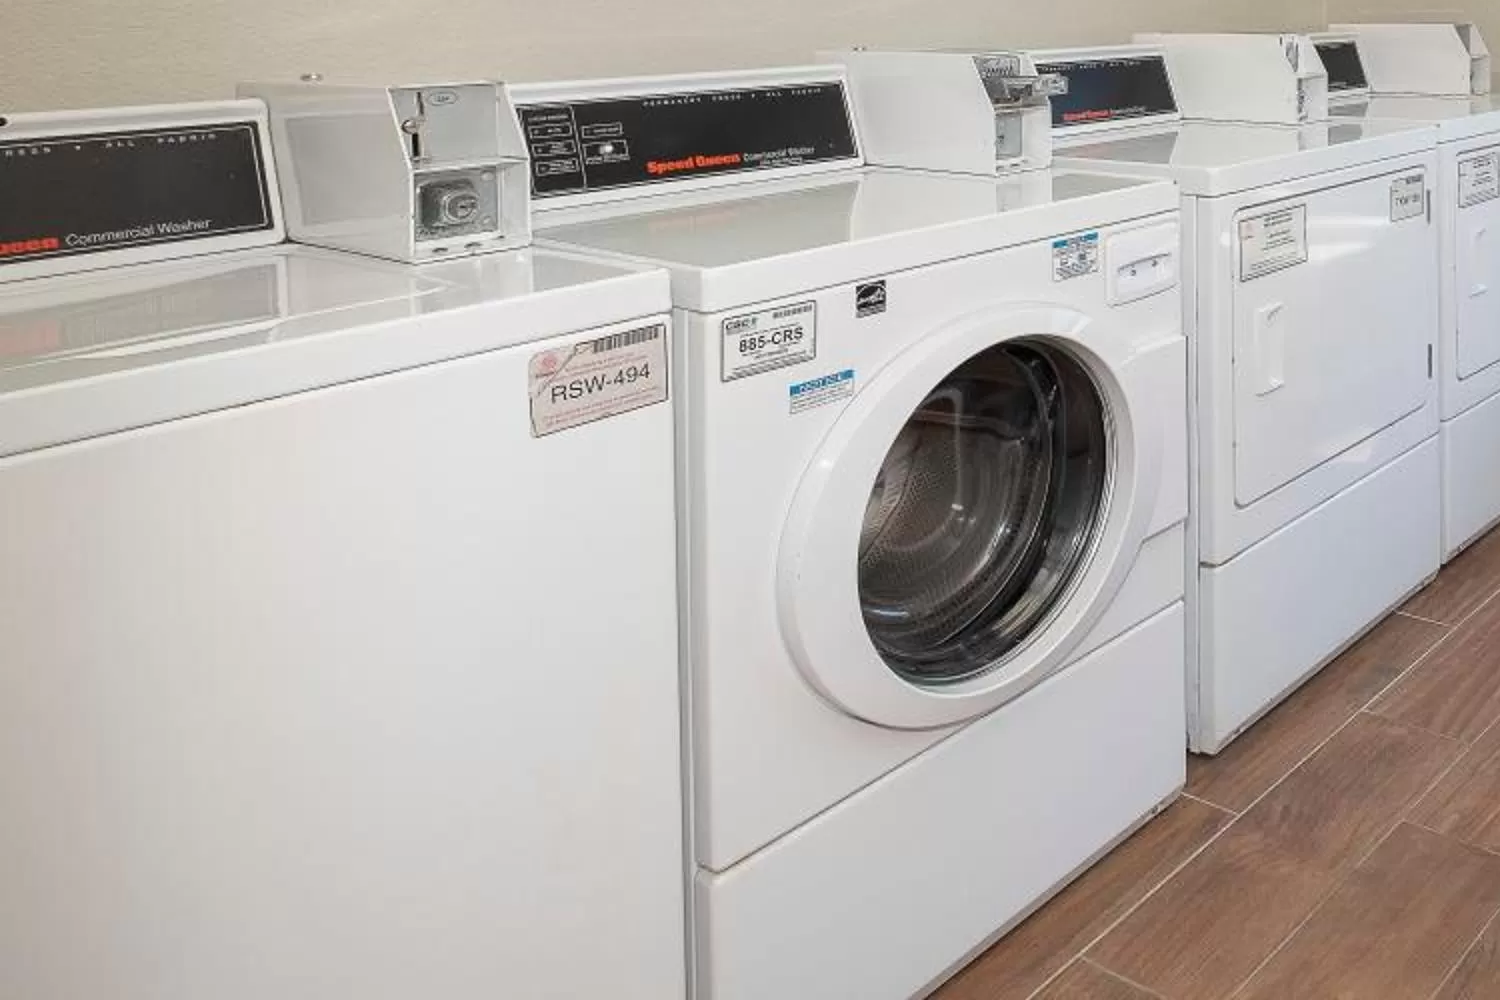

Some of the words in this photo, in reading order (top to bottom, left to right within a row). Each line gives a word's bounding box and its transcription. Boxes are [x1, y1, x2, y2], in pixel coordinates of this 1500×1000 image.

[647, 156, 695, 174] Speed
[696, 152, 740, 167] Queen
[65, 225, 154, 247] Commercial
[155, 218, 212, 234] Washer
[739, 326, 804, 353] 885-CRS
[550, 363, 651, 404] RSW-494
